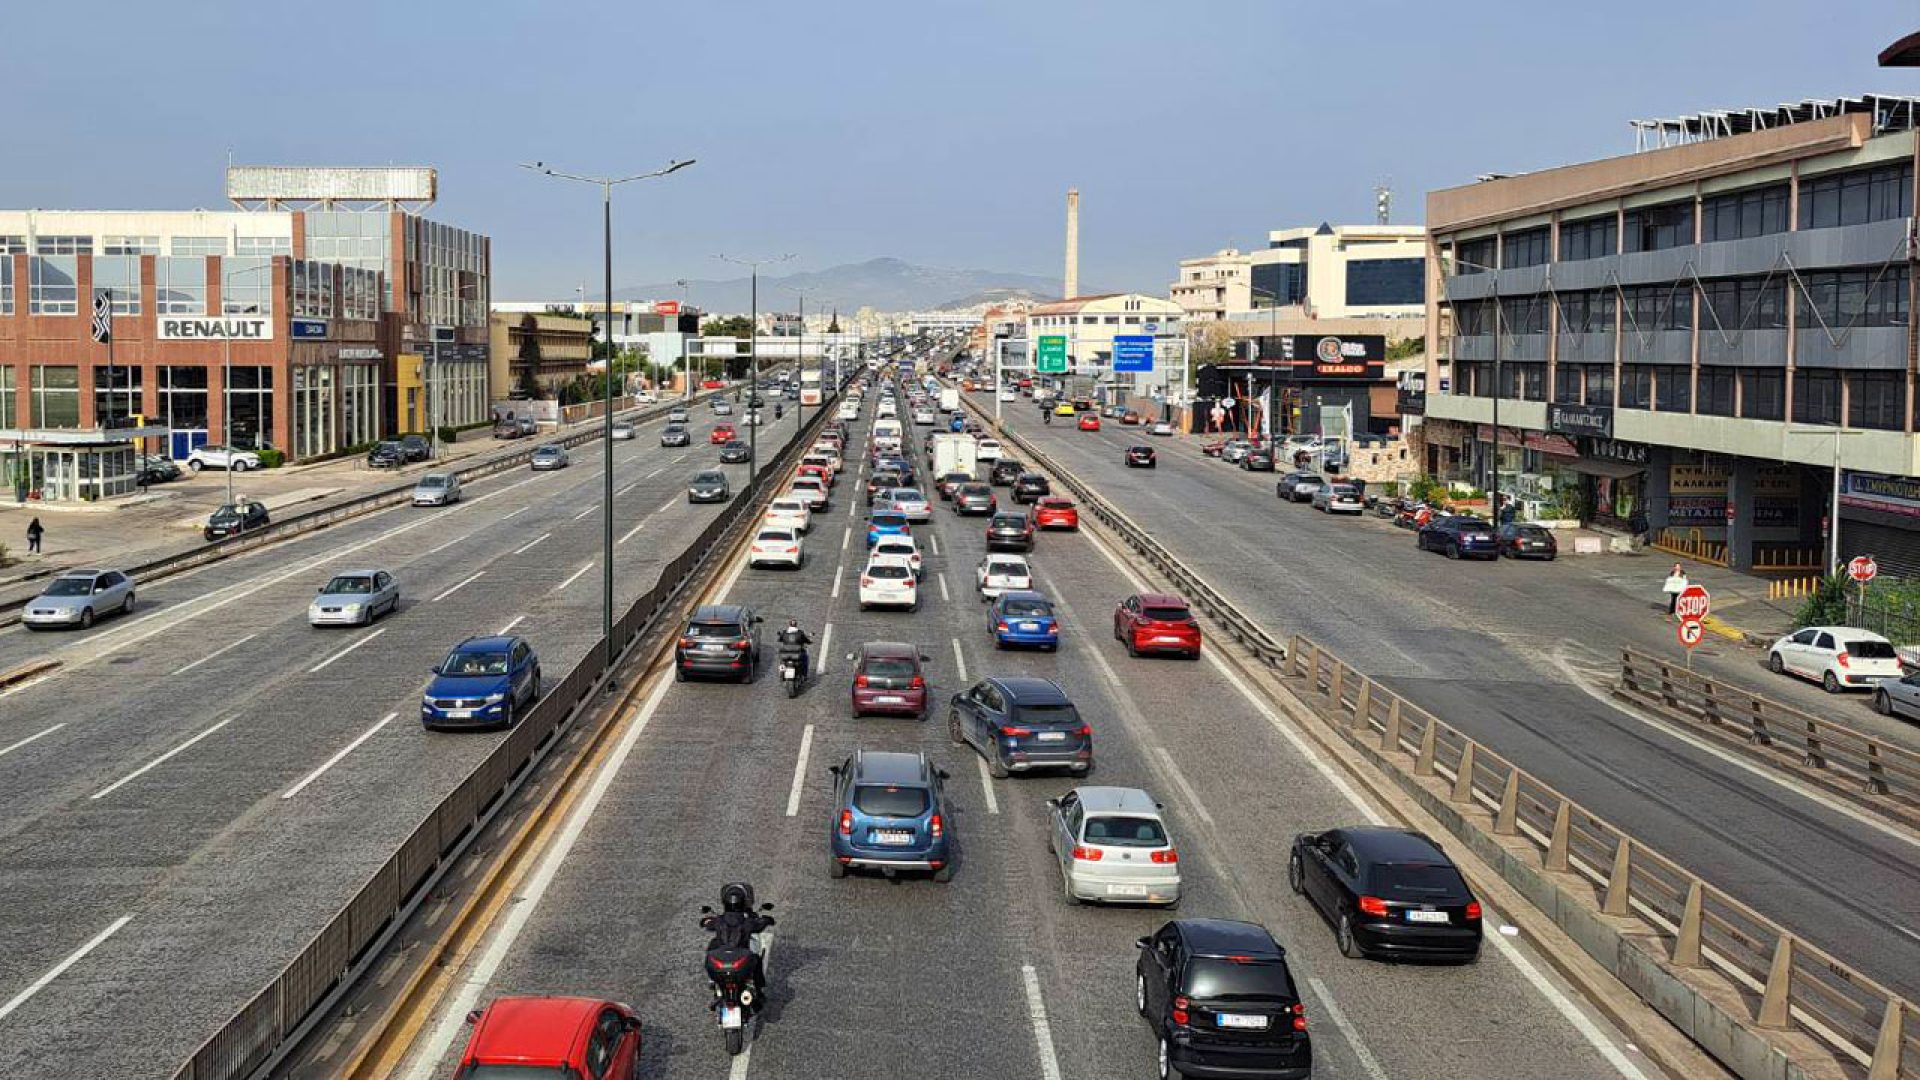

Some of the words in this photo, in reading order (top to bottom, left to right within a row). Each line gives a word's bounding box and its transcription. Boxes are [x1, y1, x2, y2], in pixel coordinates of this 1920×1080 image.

[164, 320, 264, 337] RENAULT
[1849, 564, 1876, 575] STOP
[1679, 596, 1707, 616] STOP
